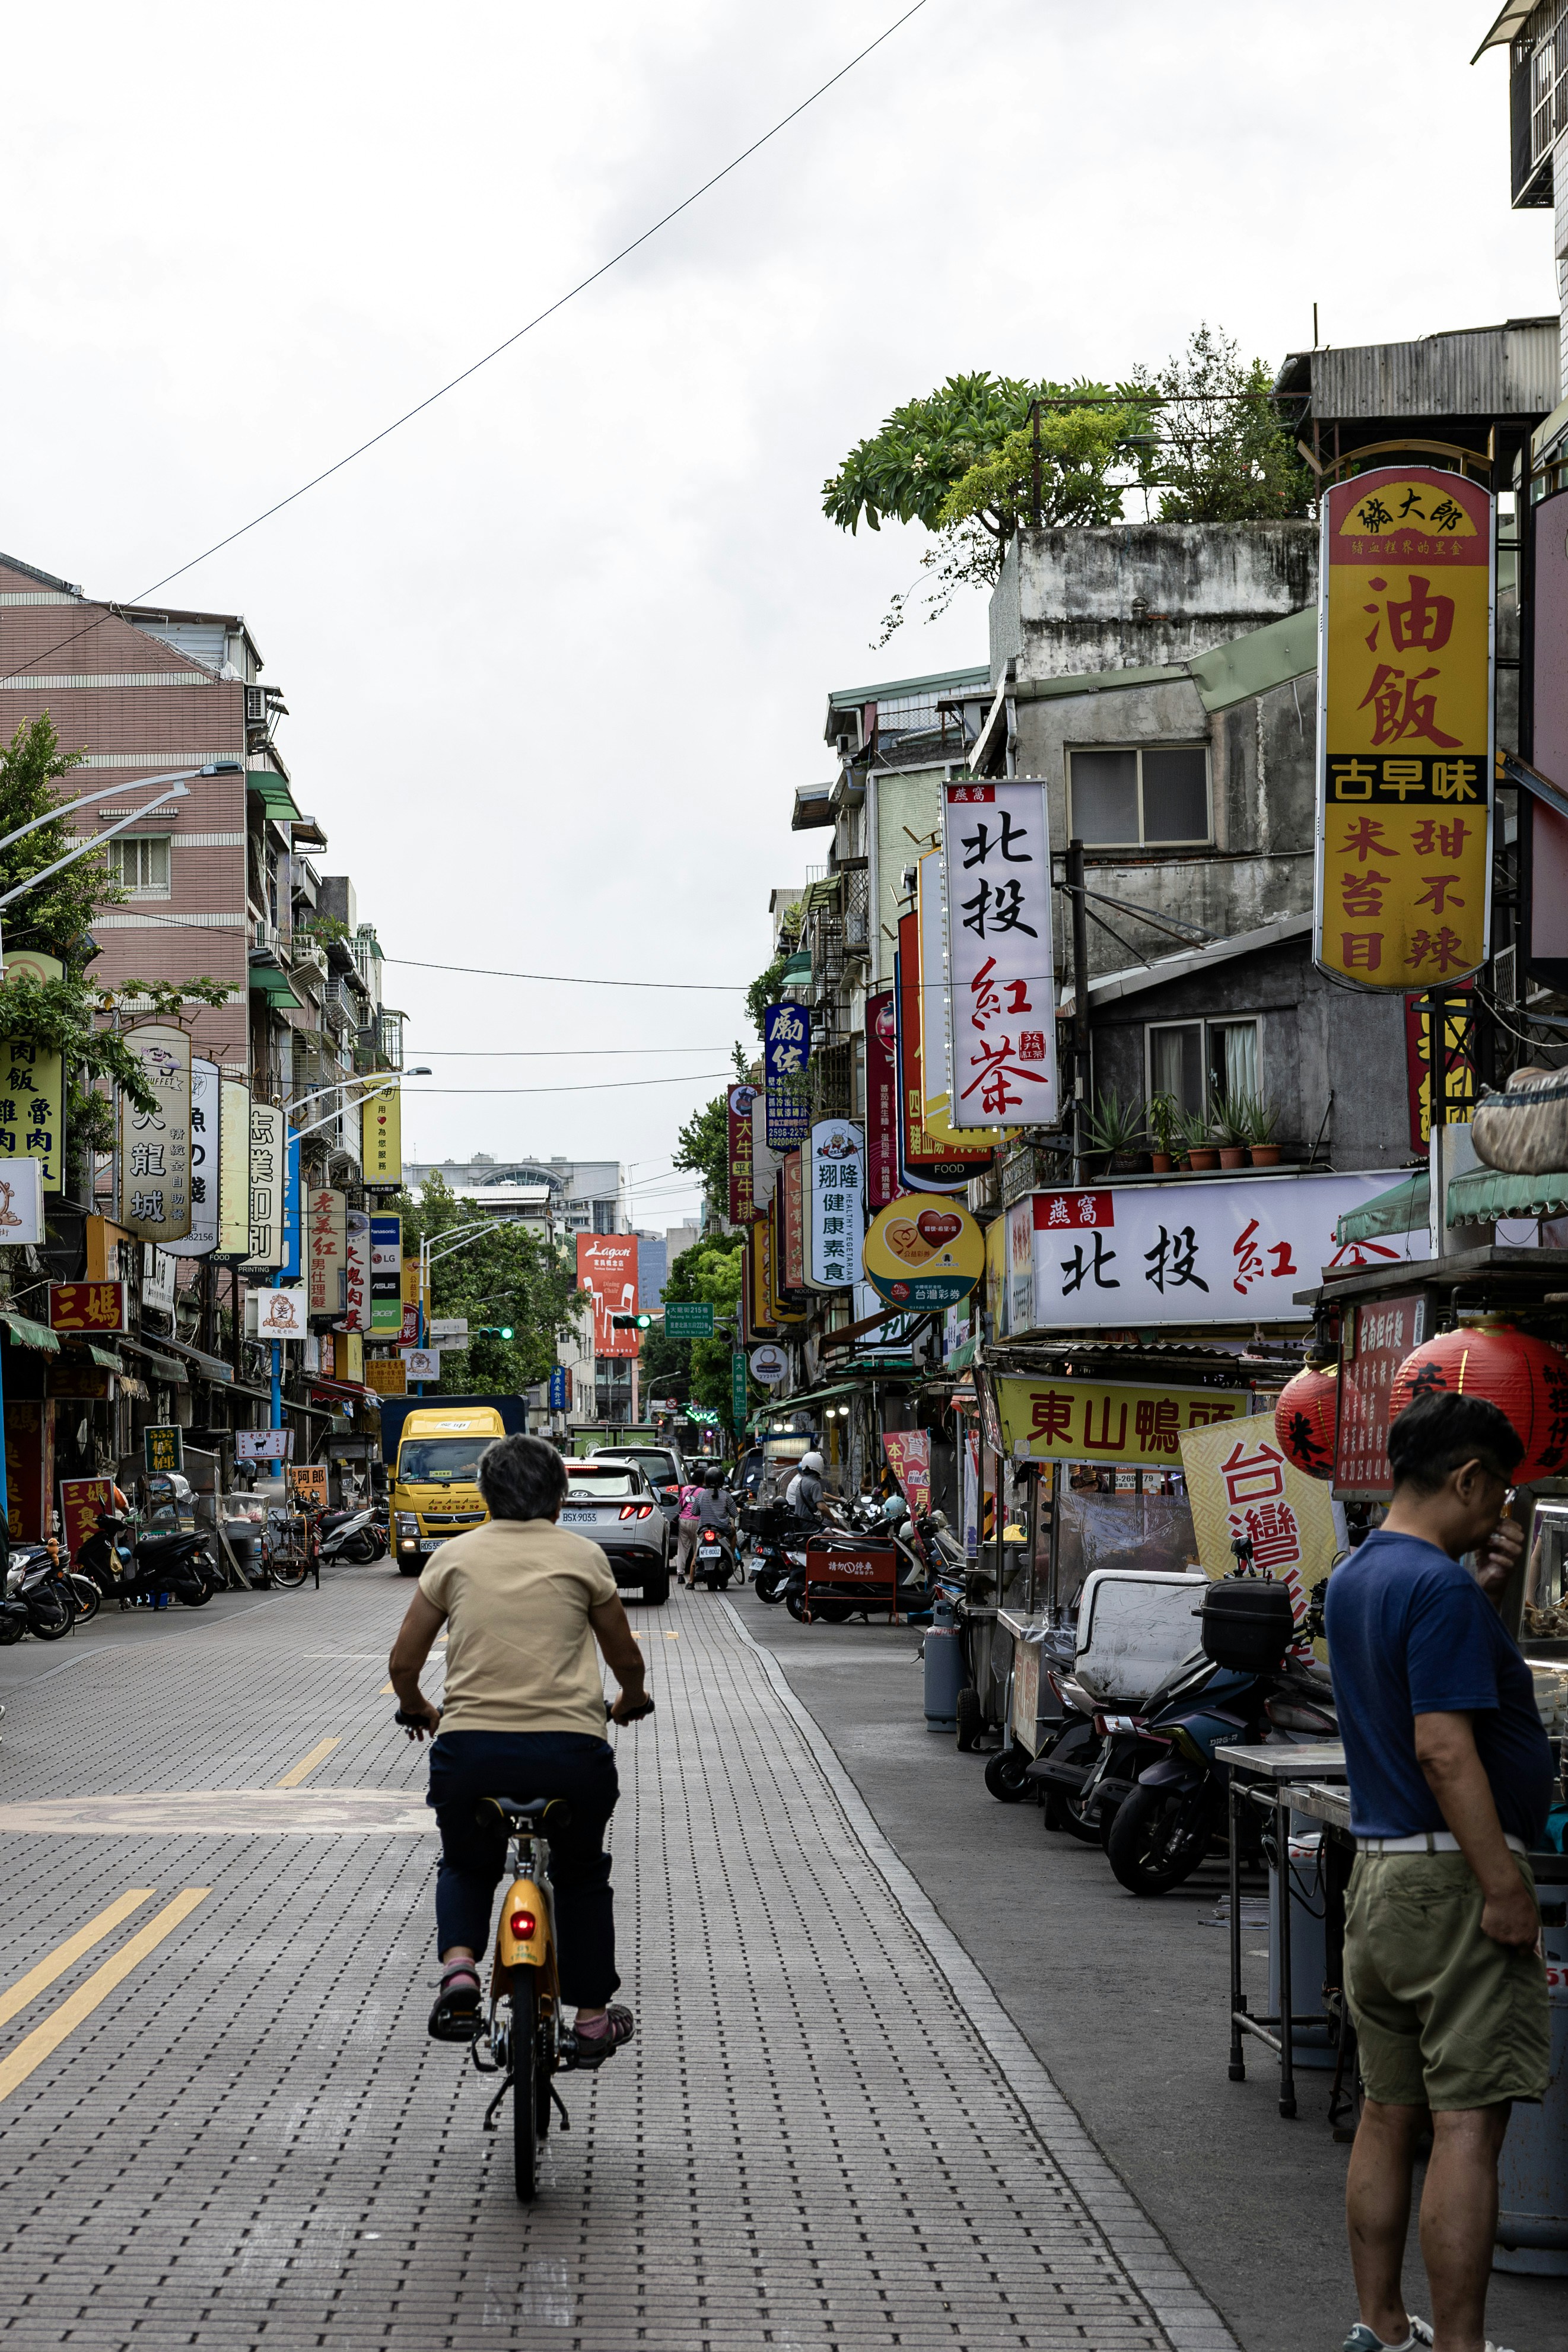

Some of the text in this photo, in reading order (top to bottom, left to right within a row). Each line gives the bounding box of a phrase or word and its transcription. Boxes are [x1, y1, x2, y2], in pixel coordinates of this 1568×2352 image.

[1357, 574, 1464, 748] 油飯
[953, 786, 985, 802] 燕窩
[1331, 758, 1477, 802] 古早味
[1337, 816, 1401, 971] 米苔目
[1403, 818, 1473, 974] 甜不辣
[960, 811, 1048, 1115] 北投紅茶
[5, 1026, 39, 1092] 肉飯
[934, 1164, 965, 1174] FOOD
[1048, 1194, 1097, 1226] 燕窩
[822, 1193, 845, 1282] 健康素食
[384, 1254, 396, 1263] LG
[53, 1285, 120, 1328] 三媽
[915, 1289, 960, 1299] 台灣彩券
[150, 1429, 175, 1438] 555
[298, 1470, 325, 1484] 阿郎
[65, 1482, 109, 1507] 三媽
[563, 1512, 596, 1522] BSX-9033
[855, 1562, 873, 1571] 停車
